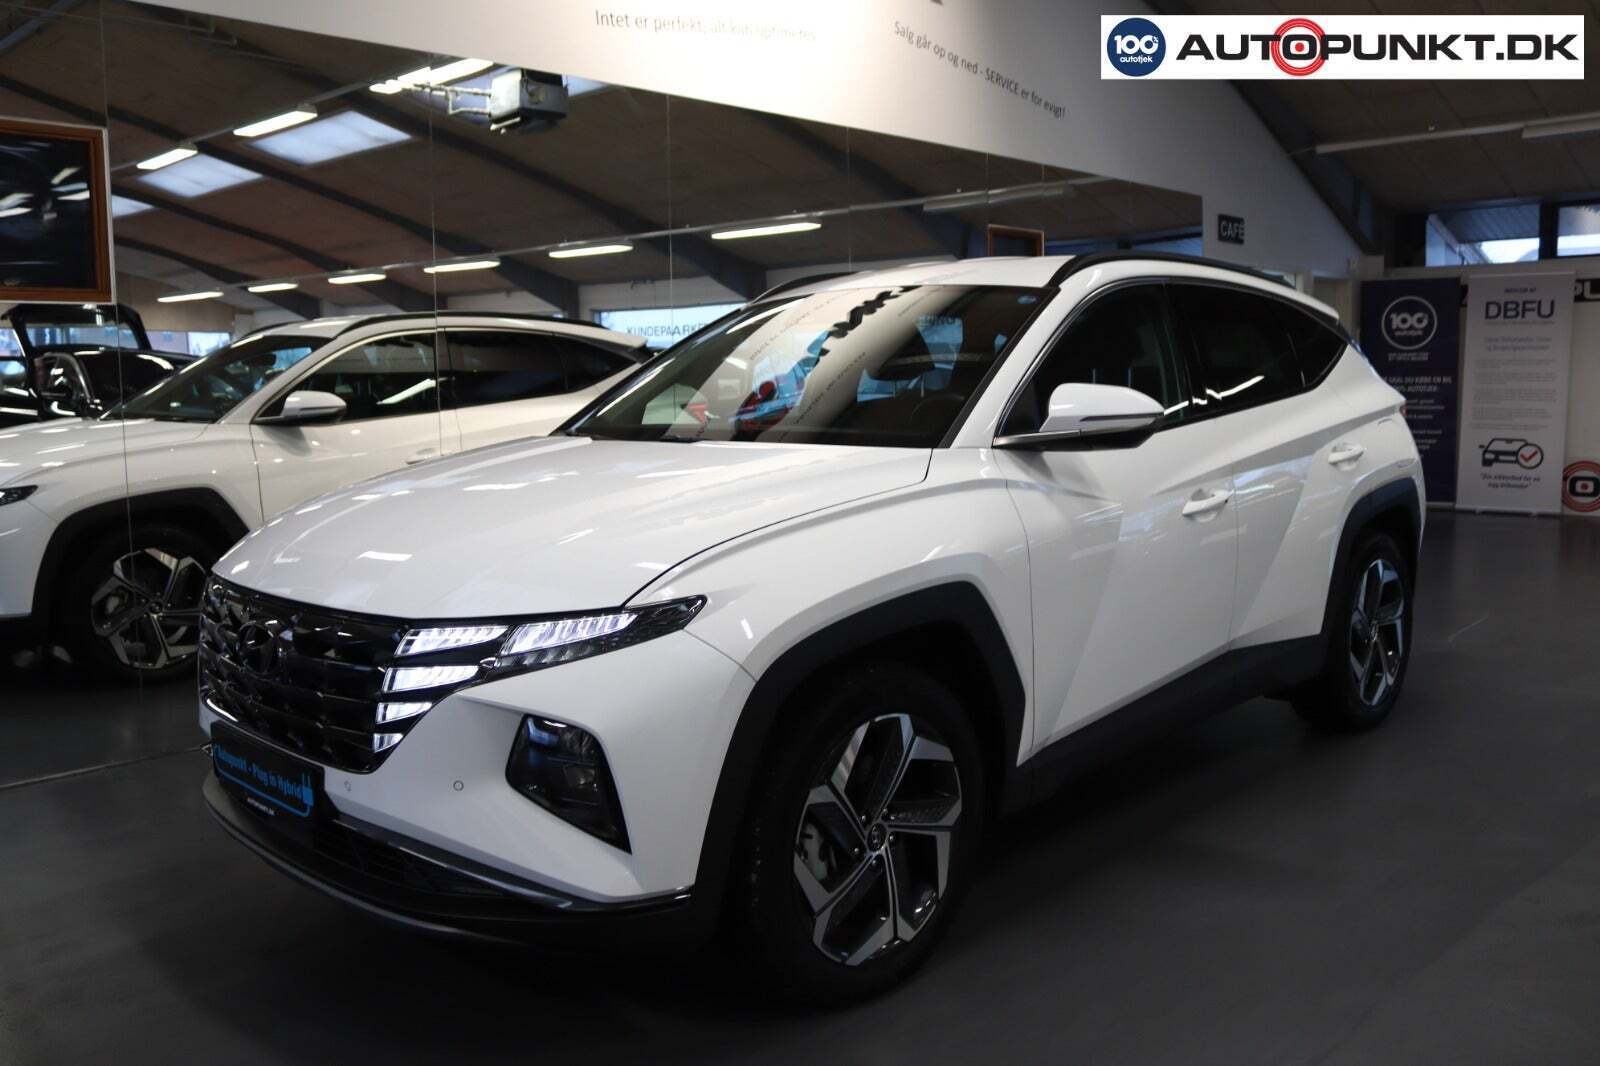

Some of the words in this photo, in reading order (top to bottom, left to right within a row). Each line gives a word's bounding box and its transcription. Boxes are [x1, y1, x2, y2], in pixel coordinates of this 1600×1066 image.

[595, 9, 630, 28] Intet
[634, 16, 648, 29] er
[894, 21, 914, 45] Salg
[916, 34, 932, 49] går
[933, 44, 946, 59] op
[947, 52, 960, 67] og
[961, 57, 979, 74] ned
[984, 67, 1020, 96] SERVICE
[1484, 299, 1556, 320] DBFU
